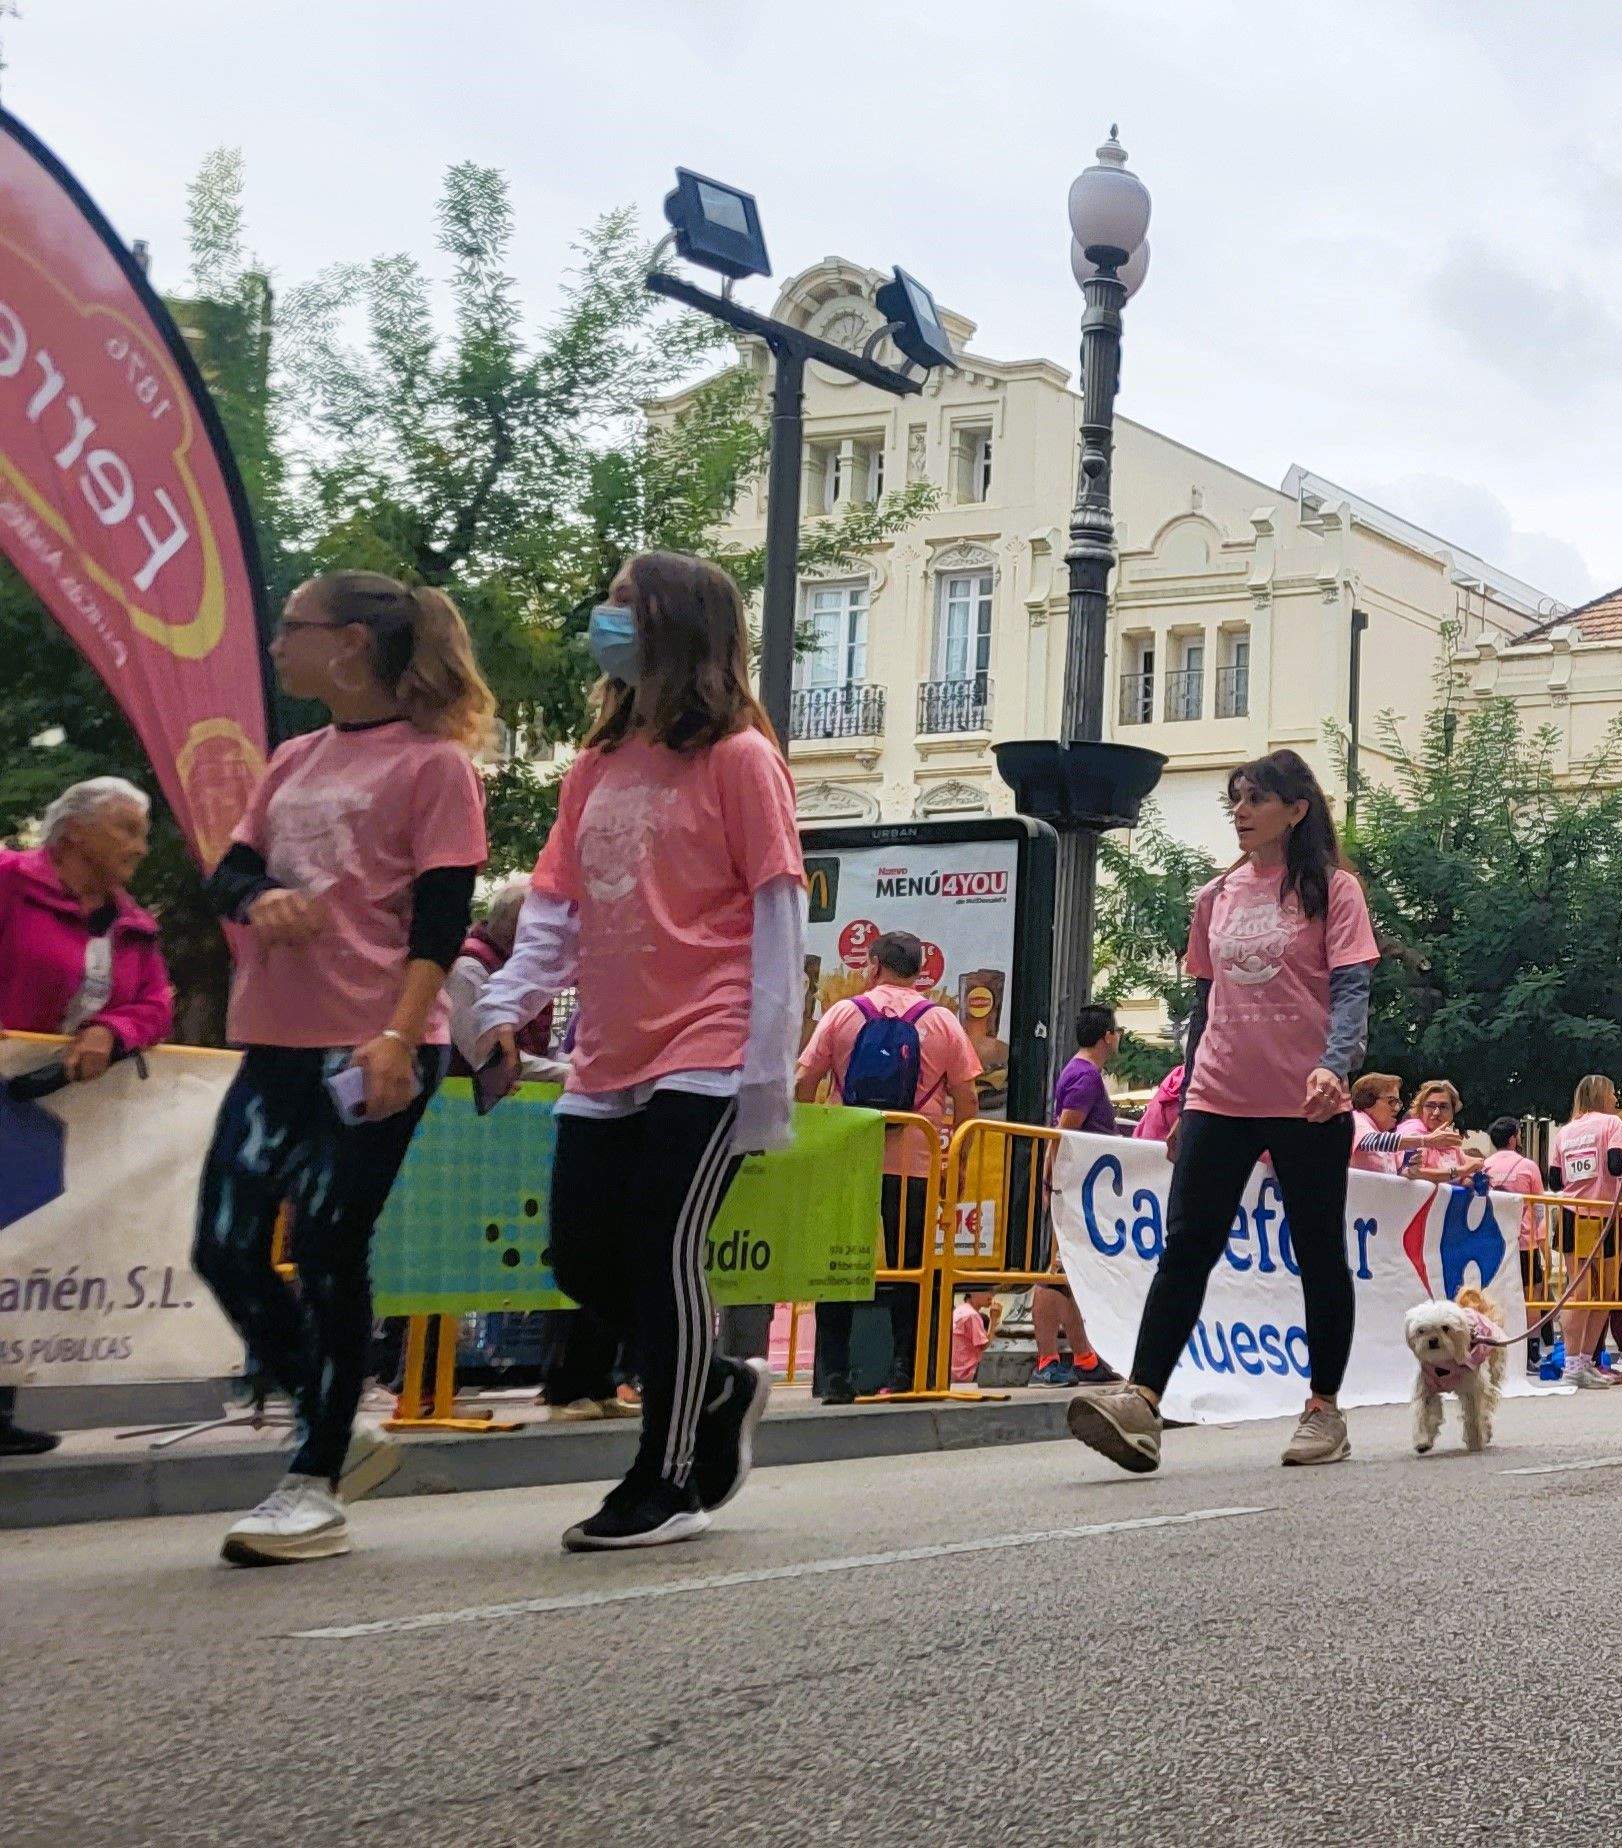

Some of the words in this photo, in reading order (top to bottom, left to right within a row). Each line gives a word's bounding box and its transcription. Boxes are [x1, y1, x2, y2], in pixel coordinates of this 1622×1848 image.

[873, 828, 918, 839] URBAN
[876, 869, 941, 899] MENÚ
[943, 872, 1007, 895] 4YOU
[1571, 1159, 1592, 1174] 106
[123, 1265, 194, 1309] S.L.
